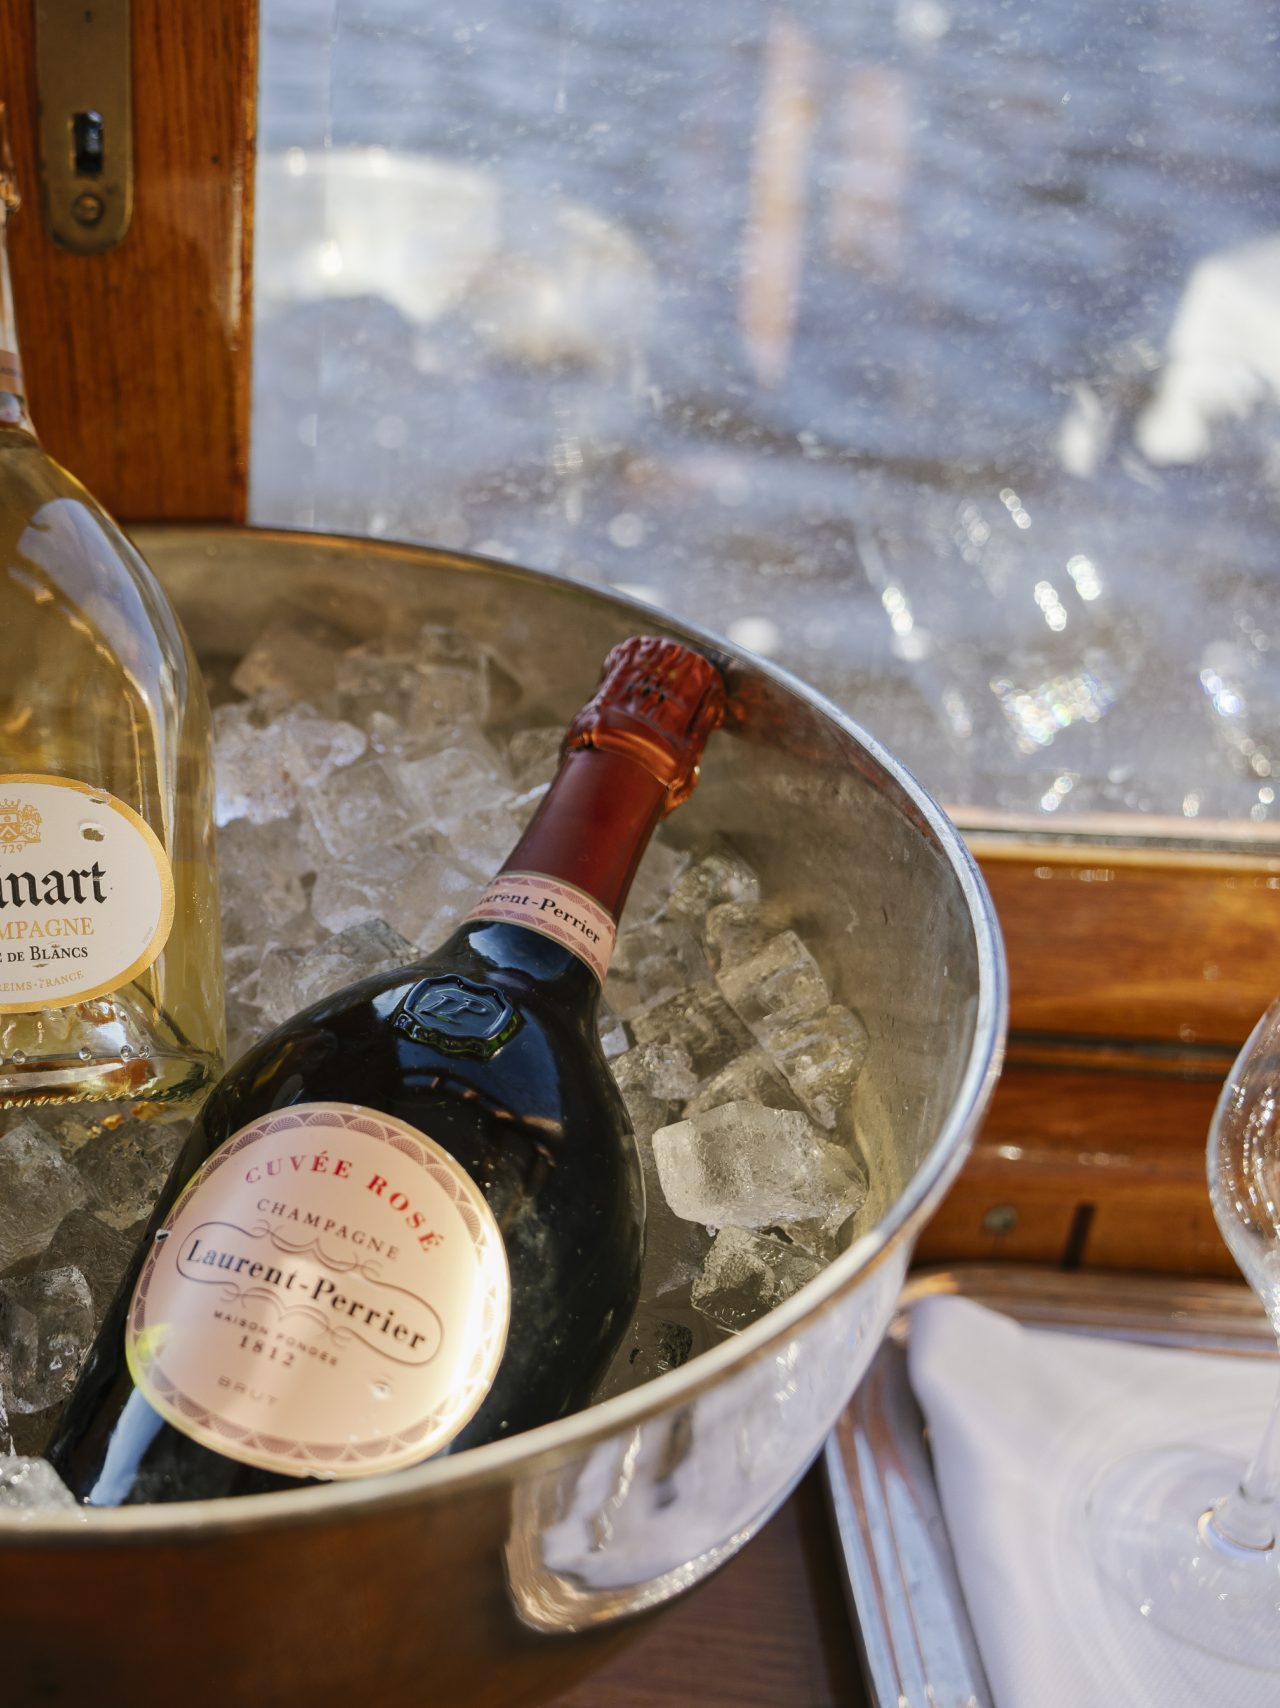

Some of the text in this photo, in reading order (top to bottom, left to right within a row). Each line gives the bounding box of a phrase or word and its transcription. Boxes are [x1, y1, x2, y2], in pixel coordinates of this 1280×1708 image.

[29, 945, 88, 961] BLANCS
[245, 1151, 445, 1253] CUVÉE ROSÉ
[256, 1198, 401, 1261] CHAMPAGNE
[186, 1239, 426, 1350] Laurent-Perrier
[240, 1335, 295, 1367] 1812
[217, 1376, 280, 1404] BRUT
